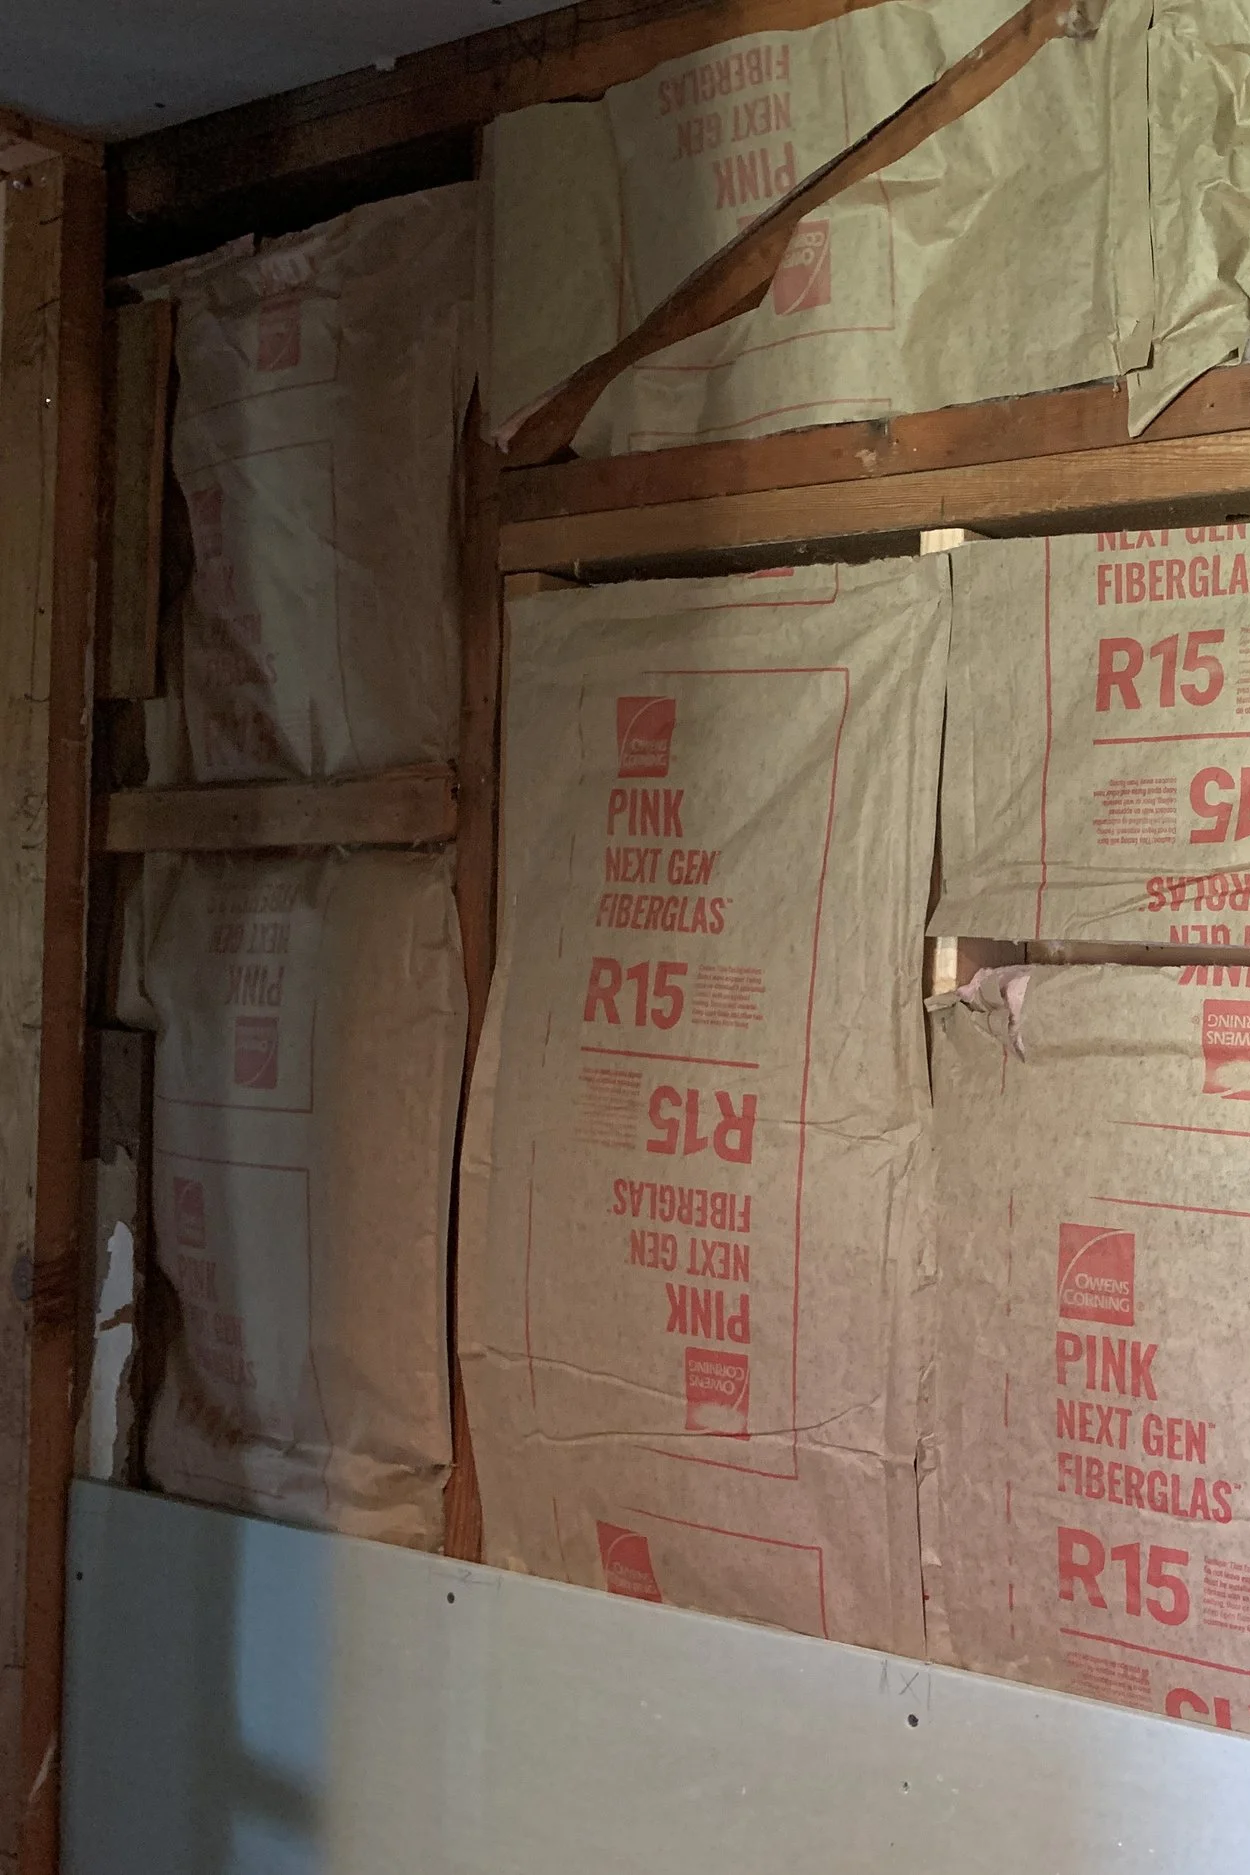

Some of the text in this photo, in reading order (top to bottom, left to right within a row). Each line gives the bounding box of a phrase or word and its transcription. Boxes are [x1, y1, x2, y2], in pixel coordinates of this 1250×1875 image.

[657, 44, 790, 117] FIBERGLAS
[676, 91, 791, 160] NEXT GEN
[712, 141, 797, 209] PINK
[1095, 629, 1226, 712] R15
[606, 788, 685, 839] PINK
[605, 846, 715, 887] NEXT GEN
[594, 893, 726, 935] FIBERGLAS
[582, 956, 688, 1030] R15
[646, 1084, 758, 1165] R15
[613, 1178, 751, 1233] FIBERGLAS
[630, 1228, 749, 1282] NEXT GEN
[1075, 1272, 1130, 1296] OWENS
[666, 1283, 751, 1344] PINK
[1062, 1287, 1130, 1313] CORNING
[688, 1360, 745, 1381] CORNING
[689, 1374, 735, 1395] OWENS
[1056, 1331, 1159, 1401] PINK
[1056, 1398, 1207, 1465] NEXT GEN
[1057, 1452, 1234, 1525] FIBERGLAS
[1058, 1526, 1190, 1626] R15
